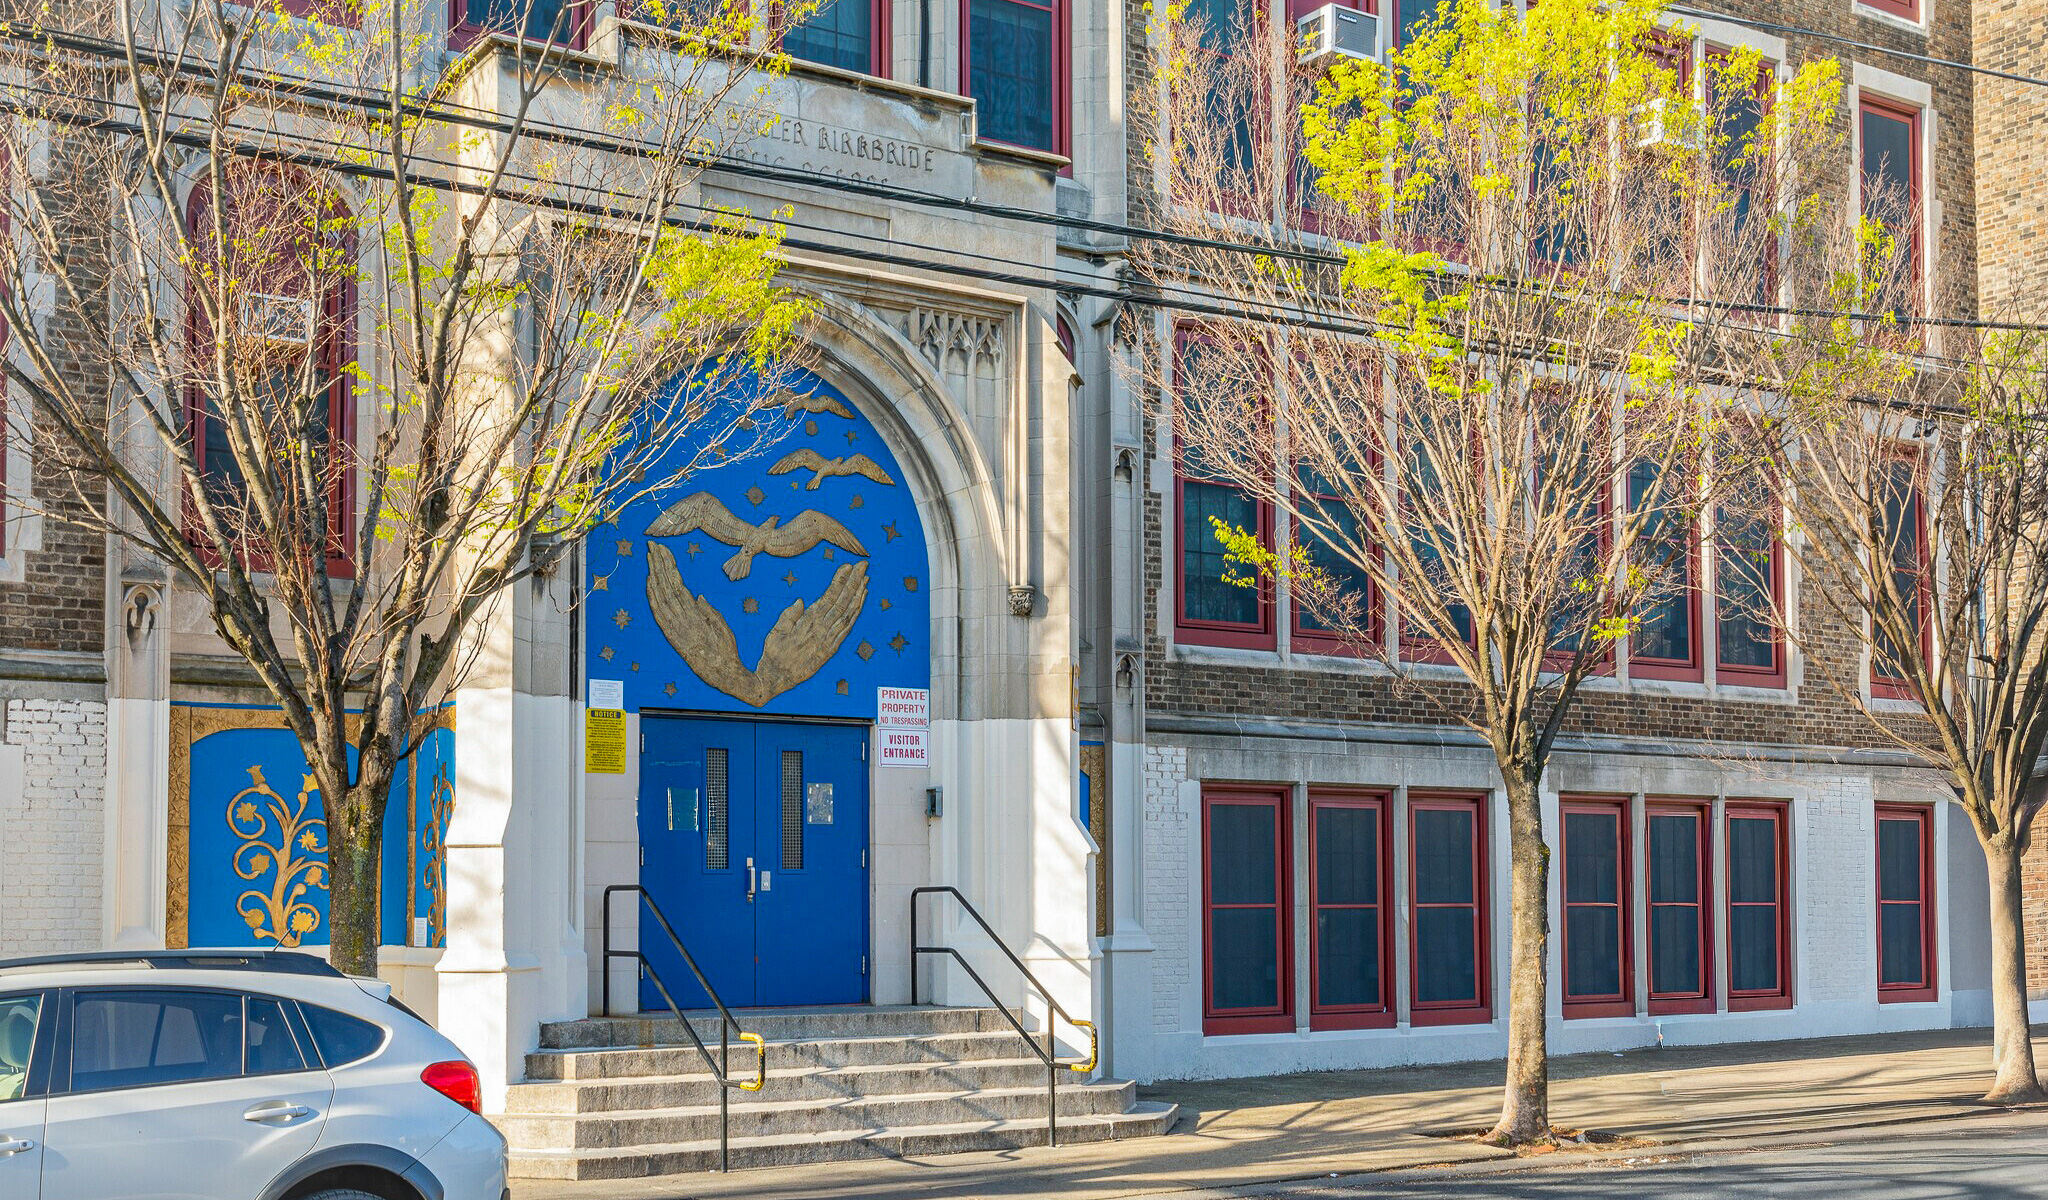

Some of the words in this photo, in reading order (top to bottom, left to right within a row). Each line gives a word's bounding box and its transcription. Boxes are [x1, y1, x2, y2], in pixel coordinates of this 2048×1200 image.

[818, 126, 935, 172] KIRKBRIDE
[881, 689, 926, 701] PRIVATE
[881, 703, 926, 714] PROPERTY
[594, 710, 617, 719] NOTICE
[880, 716, 889, 724] NO
[891, 717, 928, 726] TRESPASSING
[888, 734, 920, 745] VISITOR
[883, 748, 925, 759] ENTRANCE
